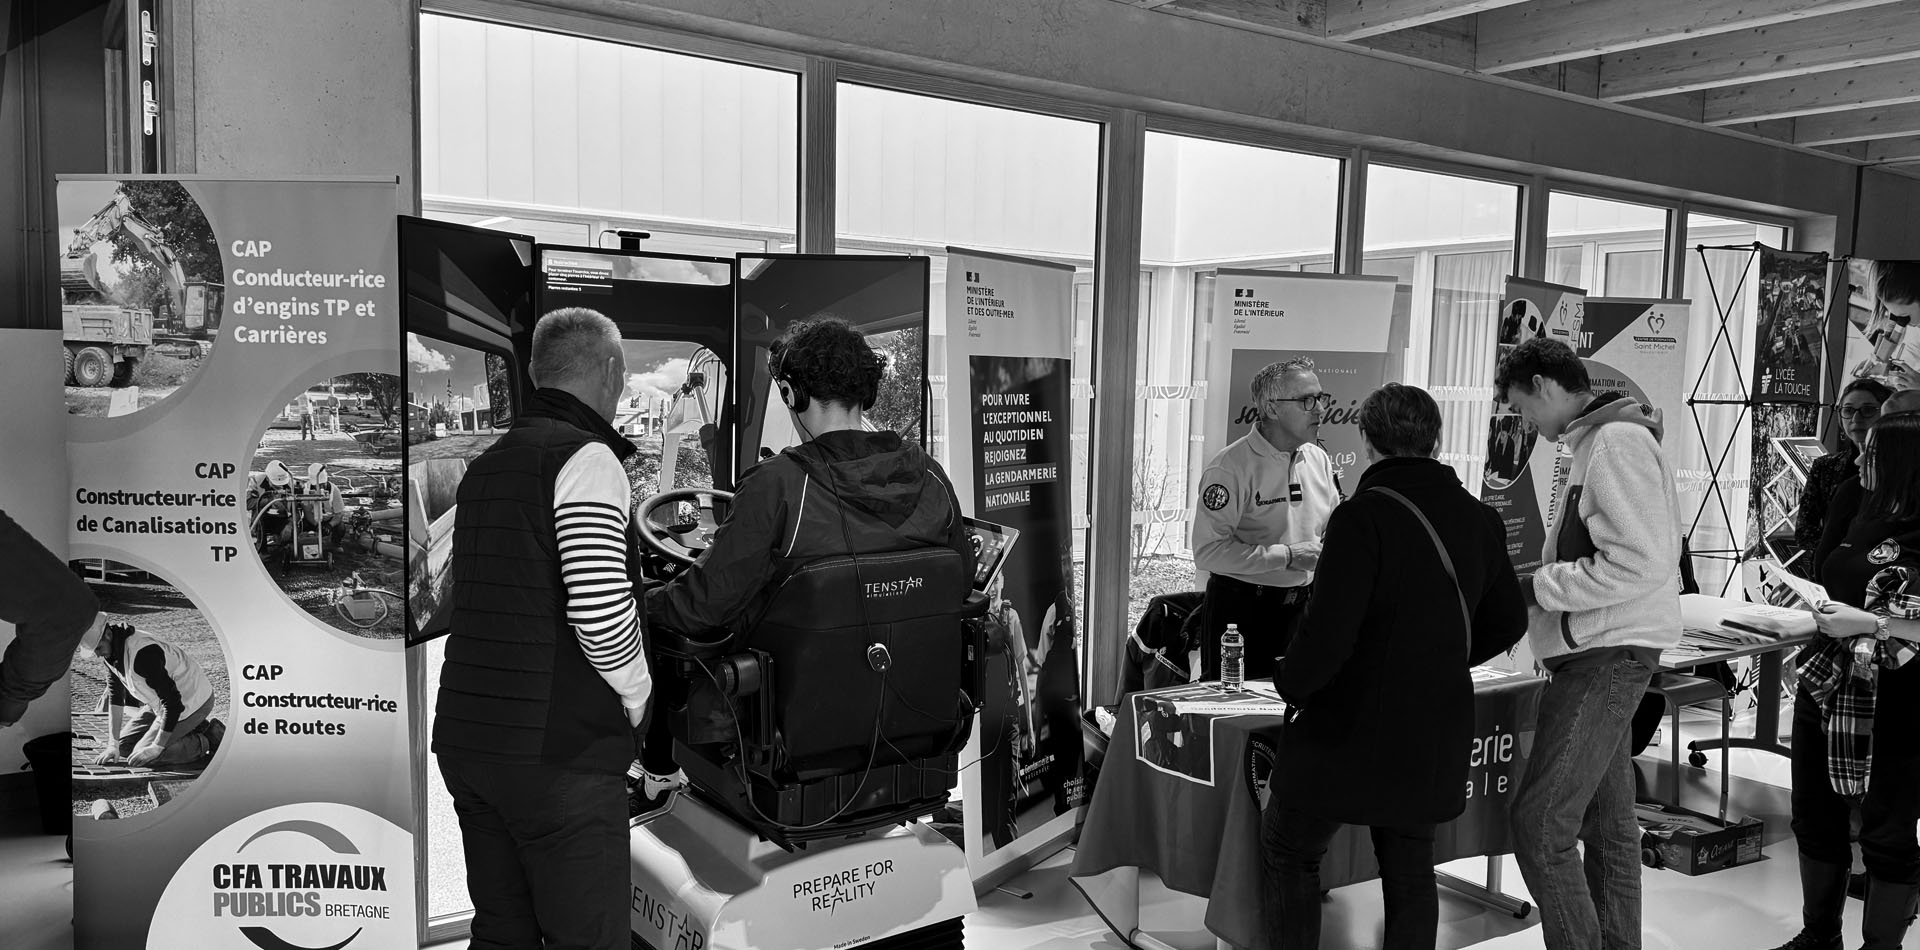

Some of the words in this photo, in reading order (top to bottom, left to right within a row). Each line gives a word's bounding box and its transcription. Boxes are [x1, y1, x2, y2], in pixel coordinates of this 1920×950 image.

[231, 240, 272, 258] CAP
[232, 268, 386, 289] Conducteur-rice
[966, 285, 995, 297] MINISTÈRE
[323, 298, 350, 317] TP
[354, 301, 375, 318] et
[967, 296, 974, 305] DE
[1234, 299, 1270, 309] MINISTÈRE
[967, 307, 974, 315] ET
[975, 307, 985, 316] DES
[985, 308, 1014, 319] OUTRE-MER
[1244, 308, 1285, 317] L'INTÉRIEUR
[234, 326, 327, 345] Carrières
[1579, 331, 1594, 349] NT
[1634, 342, 1652, 350] Saint
[1653, 343, 1676, 351] Michel
[1775, 366, 1796, 381] LYCÉE
[1590, 378, 1616, 388] MATION
[1616, 380, 1626, 388] en
[1774, 382, 1783, 394] LA
[1784, 382, 1811, 396] TOUCHE
[982, 393, 1003, 406] POUR
[1004, 393, 1030, 406] VIVRE
[983, 410, 1052, 425] L'EXCEPTIONNEL
[984, 431, 994, 444] AU
[995, 428, 1044, 445] QUOTIDIEN
[984, 448, 1027, 465] REJOIGNEZ
[194, 462, 236, 480] CAP
[985, 473, 995, 486] LA
[995, 466, 1057, 484] GENDARMERIE
[76, 487, 237, 507] Constructeur-rice
[985, 490, 1031, 508] NATIONALE
[1546, 457, 1561, 528] FORMATION
[76, 515, 98, 533] de
[102, 516, 238, 535] Canalisations
[210, 546, 238, 562] TP
[864, 576, 923, 595] TENSTAR
[242, 664, 284, 681] CAP
[243, 692, 398, 714] Constructeur-rice
[243, 719, 269, 736] de
[275, 719, 346, 737] Routes
[1470, 725, 1513, 767] erie
[1063, 776, 1084, 788] choisir
[1066, 787, 1072, 795] le
[1465, 771, 1508, 799] ale
[213, 863, 263, 889] CFA
[268, 863, 388, 892] TRAVAUX
[793, 867, 860, 899] PREPARE
[865, 859, 894, 880] FOR
[213, 891, 321, 917] PUBLICS
[325, 903, 390, 920] BRETAGNE
[812, 880, 876, 917] REALITY
[630, 885, 704, 950] ENSTAR
[852, 935, 871, 945] Sweden
